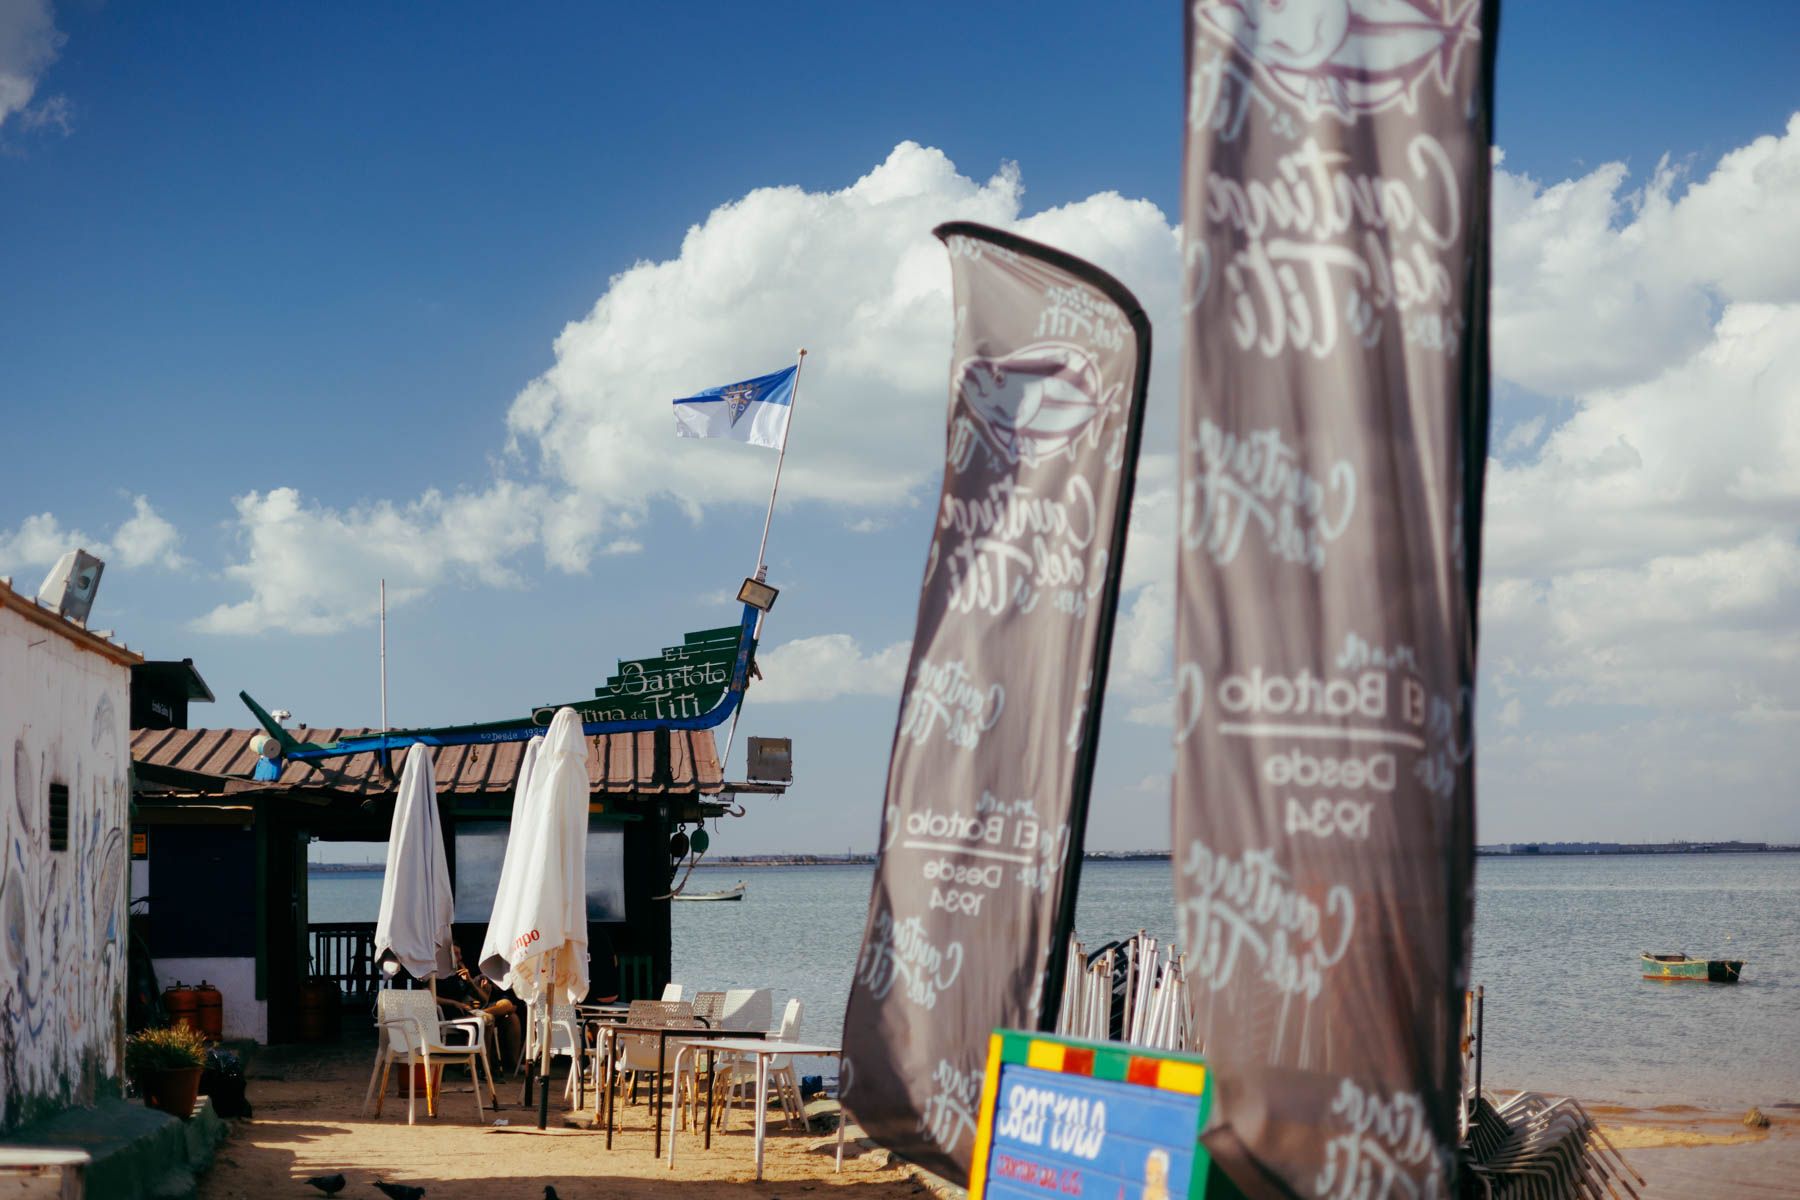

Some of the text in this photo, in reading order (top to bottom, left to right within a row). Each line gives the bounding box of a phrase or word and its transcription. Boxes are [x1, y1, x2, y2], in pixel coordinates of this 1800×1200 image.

[665, 647, 690, 662] EL
[610, 661, 727, 695] Bartolo
[630, 709, 649, 721] del
[641, 690, 703, 720] Titi
